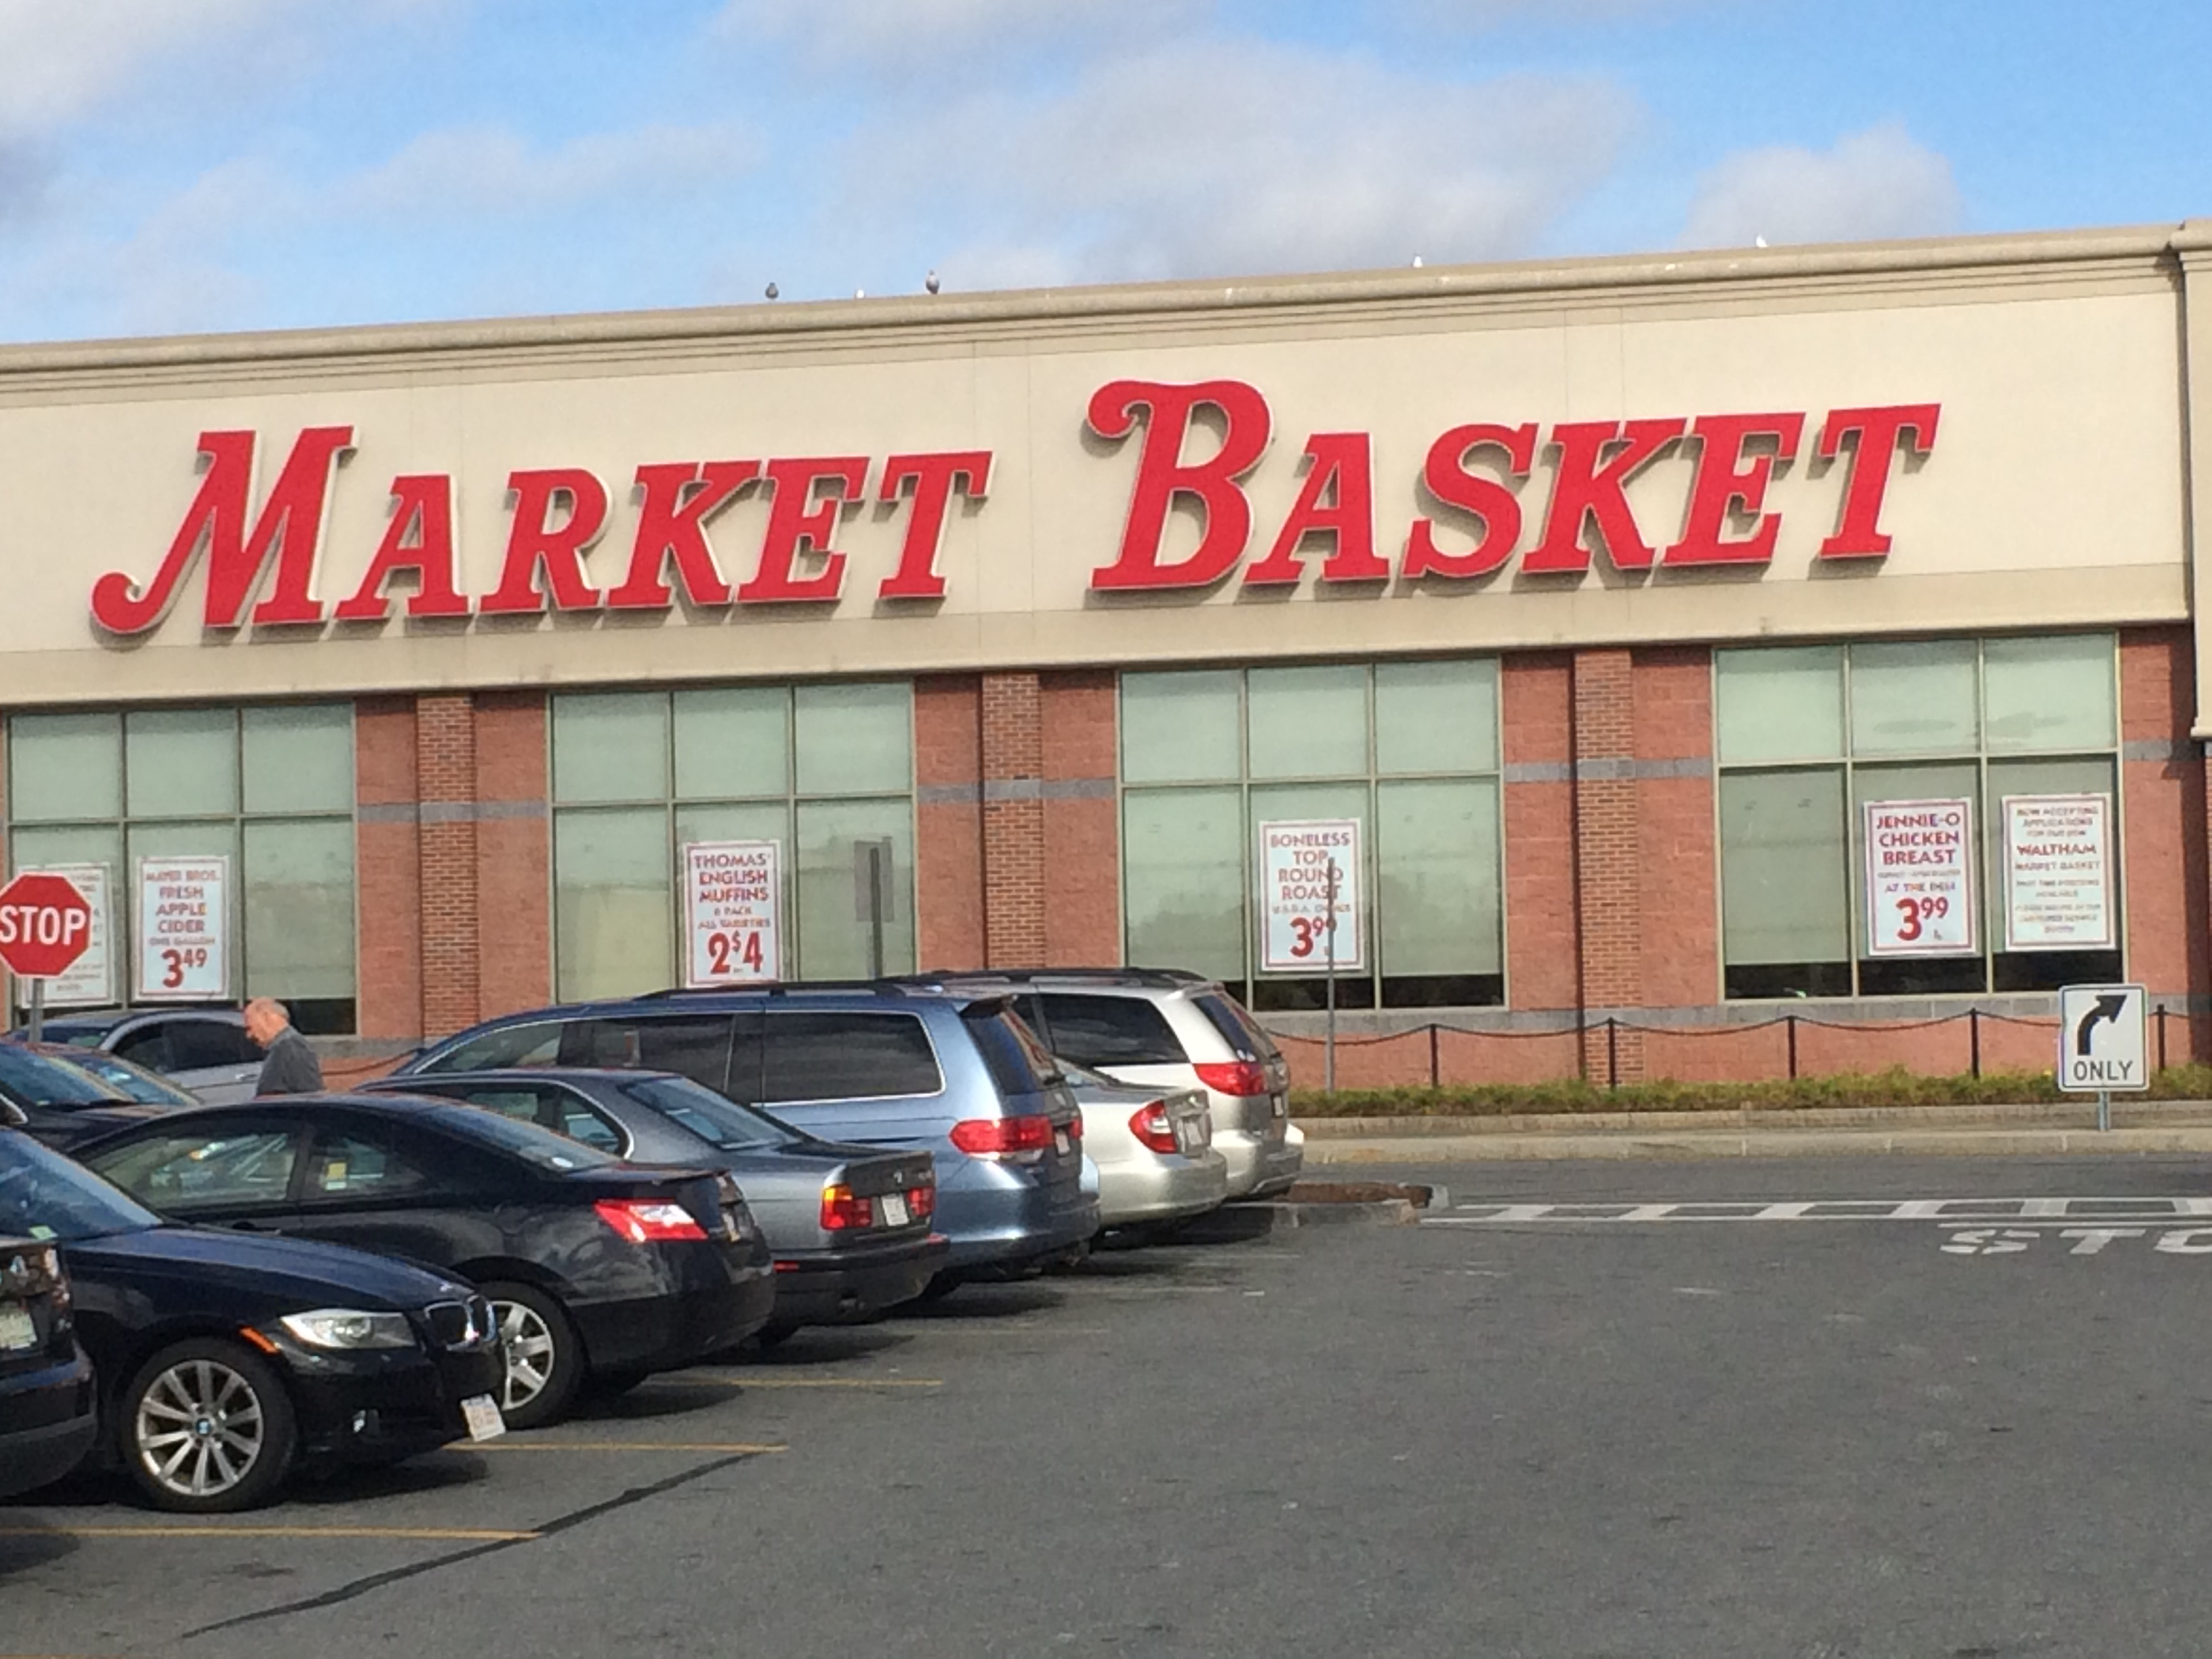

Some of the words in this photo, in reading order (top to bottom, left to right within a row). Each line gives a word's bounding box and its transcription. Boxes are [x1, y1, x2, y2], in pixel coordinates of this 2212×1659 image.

[91, 425, 994, 633] MARKET
[1088, 379, 1942, 590] BASKET
[1877, 813, 1961, 829] JENNIE-O
[1270, 832, 1351, 847] BONELESS
[1879, 831, 1959, 847] CHICKEN
[1292, 850, 1328, 865] TOP
[1883, 849, 1956, 865] BREAST
[2017, 844, 2097, 856] WALTHAM
[699, 869, 769, 885] ENGLISH
[1278, 867, 1344, 882] ROUND
[159, 886, 204, 899] FRESH
[699, 887, 769, 903] MUFFINS
[1282, 884, 1342, 900] ROAST
[155, 902, 207, 916] APPLE
[0, 904, 85, 946] STOP
[157, 920, 205, 933] CIDER
[2073, 1061, 2133, 1081] ONLY
